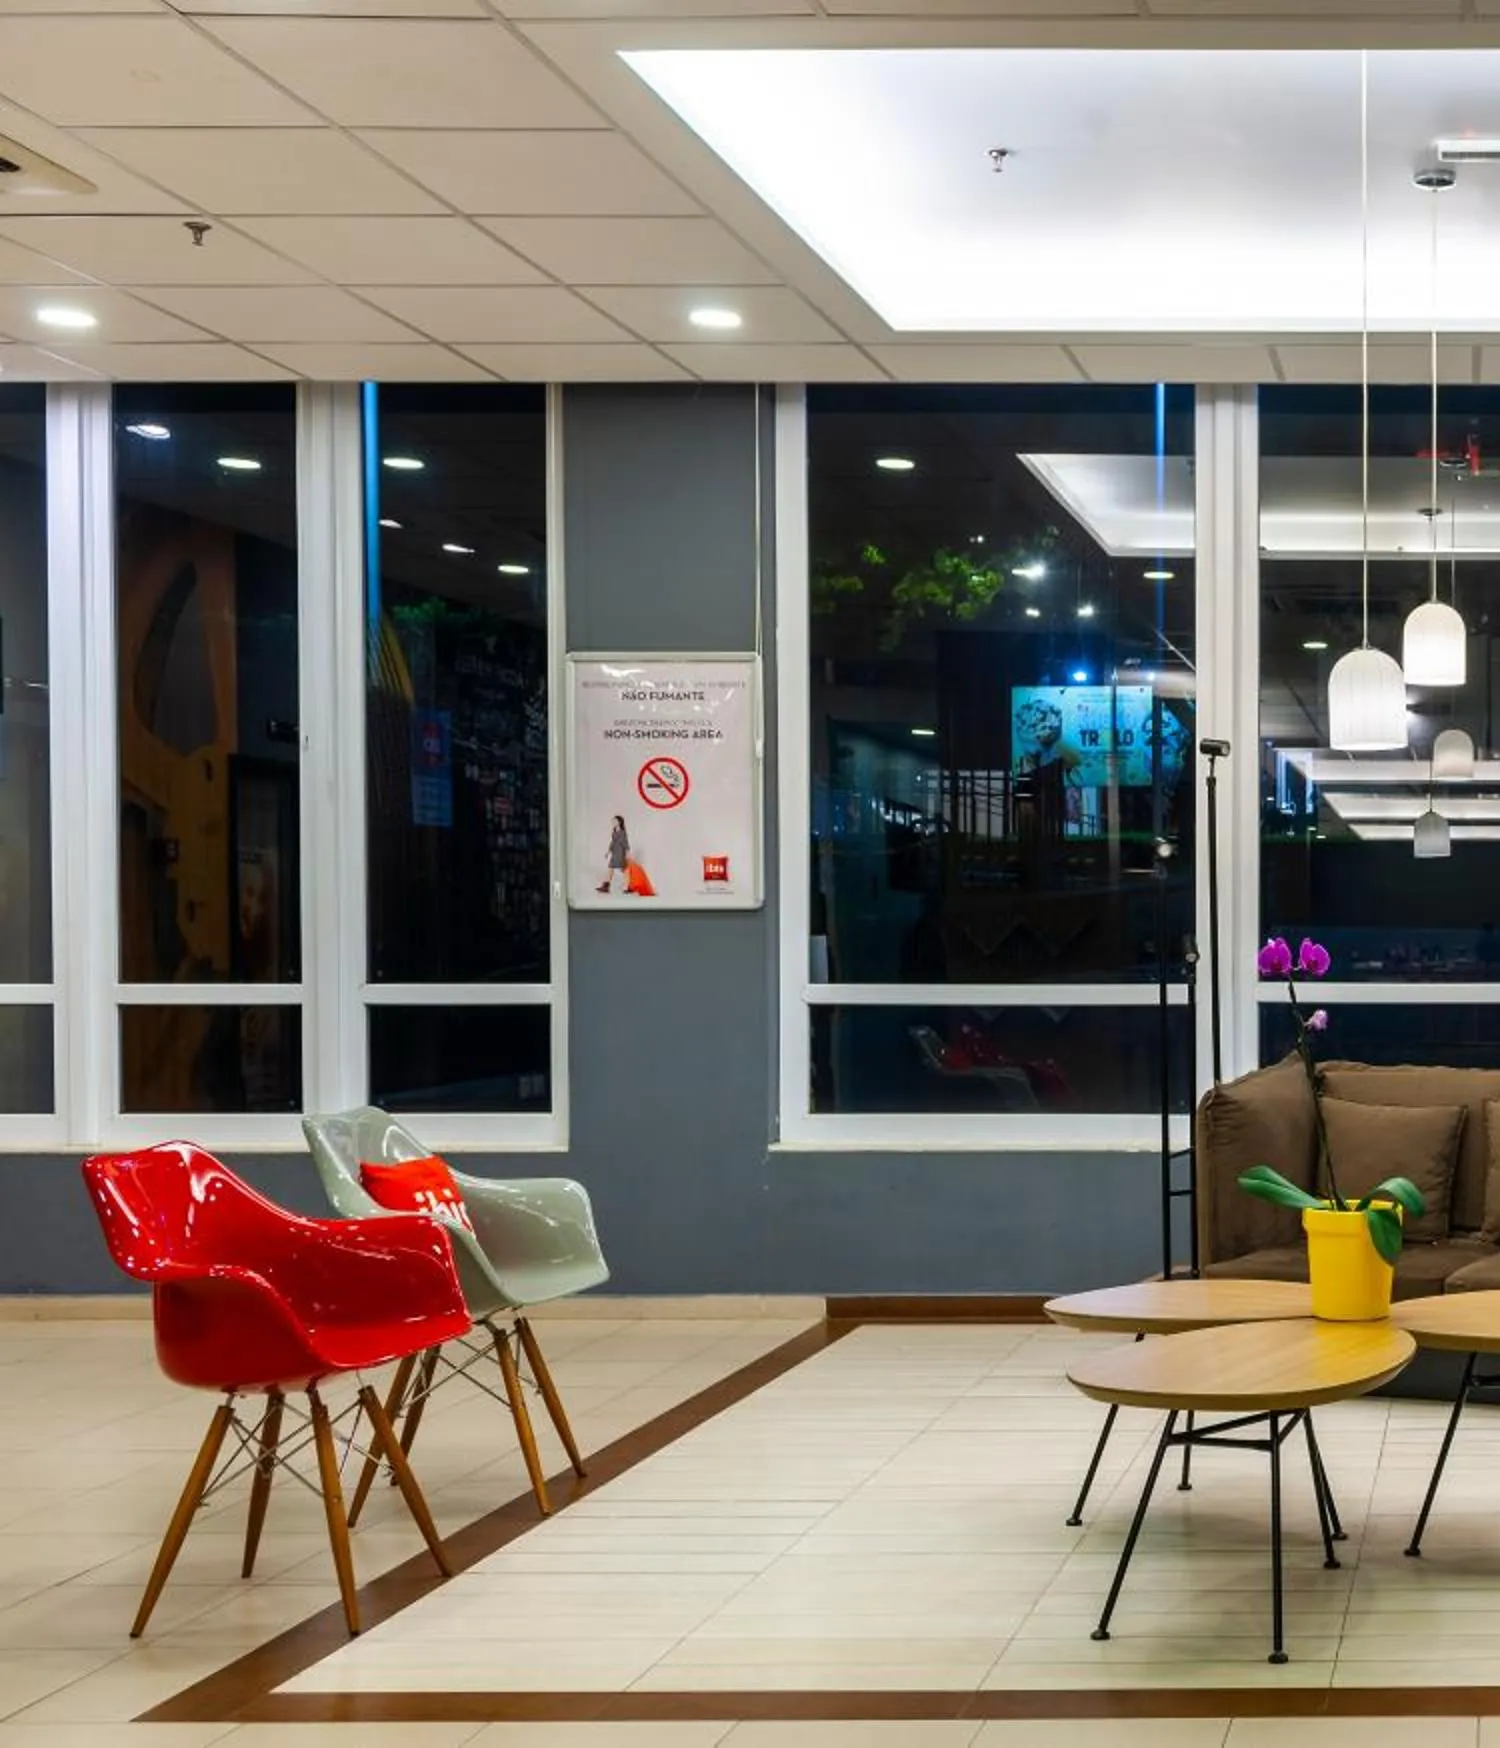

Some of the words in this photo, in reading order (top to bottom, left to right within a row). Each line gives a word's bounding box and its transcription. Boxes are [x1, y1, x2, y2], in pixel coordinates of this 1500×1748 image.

[649, 691, 705, 701] FUMANTE
[603, 729, 689, 740] NON-SMOKING
[692, 729, 724, 740] AREA
